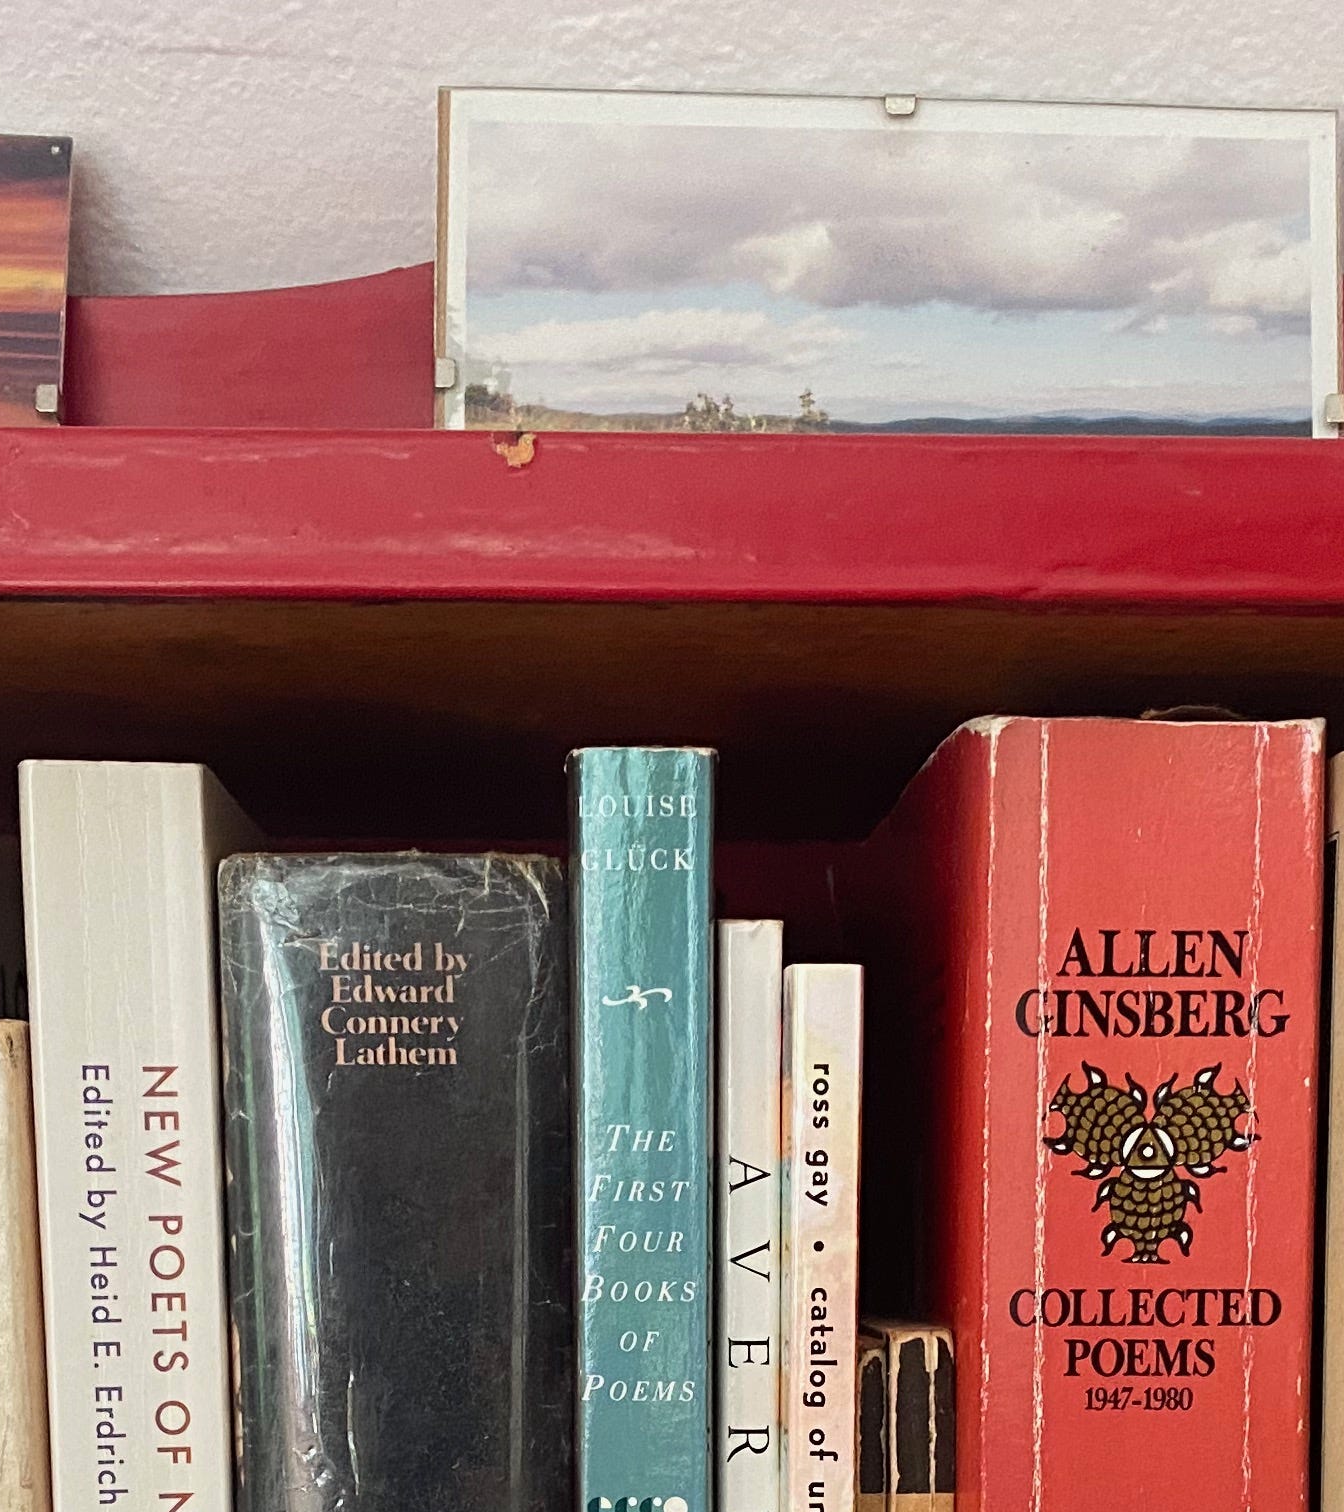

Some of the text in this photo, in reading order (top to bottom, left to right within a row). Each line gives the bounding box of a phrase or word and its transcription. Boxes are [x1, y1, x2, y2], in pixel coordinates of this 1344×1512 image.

[318, 941, 422, 972] Edited
[1057, 928, 1247, 979] ALLEN
[331, 975, 454, 1003] Edward
[321, 1007, 464, 1042] Connery
[1015, 990, 1290, 1038] GINSBERG
[335, 1038, 458, 1066] Lathem
[143, 1063, 180, 1186] NEW
[606, 1124, 676, 1151] THE
[807, 1063, 830, 1208] ross gay
[590, 1177, 691, 1202] FIRST
[592, 1226, 684, 1252] FOUR
[82, 1063, 130, 1507] Edited Heid Erdrich
[149, 1216, 188, 1373] POETS
[581, 1277, 697, 1302] BOOKS
[1010, 1288, 1282, 1327] COLLECTED
[620, 1329, 658, 1352] OF
[804, 1288, 839, 1407] catalog
[1063, 1339, 1215, 1378] POEMS
[582, 1377, 696, 1402] POEMS
[157, 1399, 192, 1464] OF
[808, 1427, 838, 1464] of
